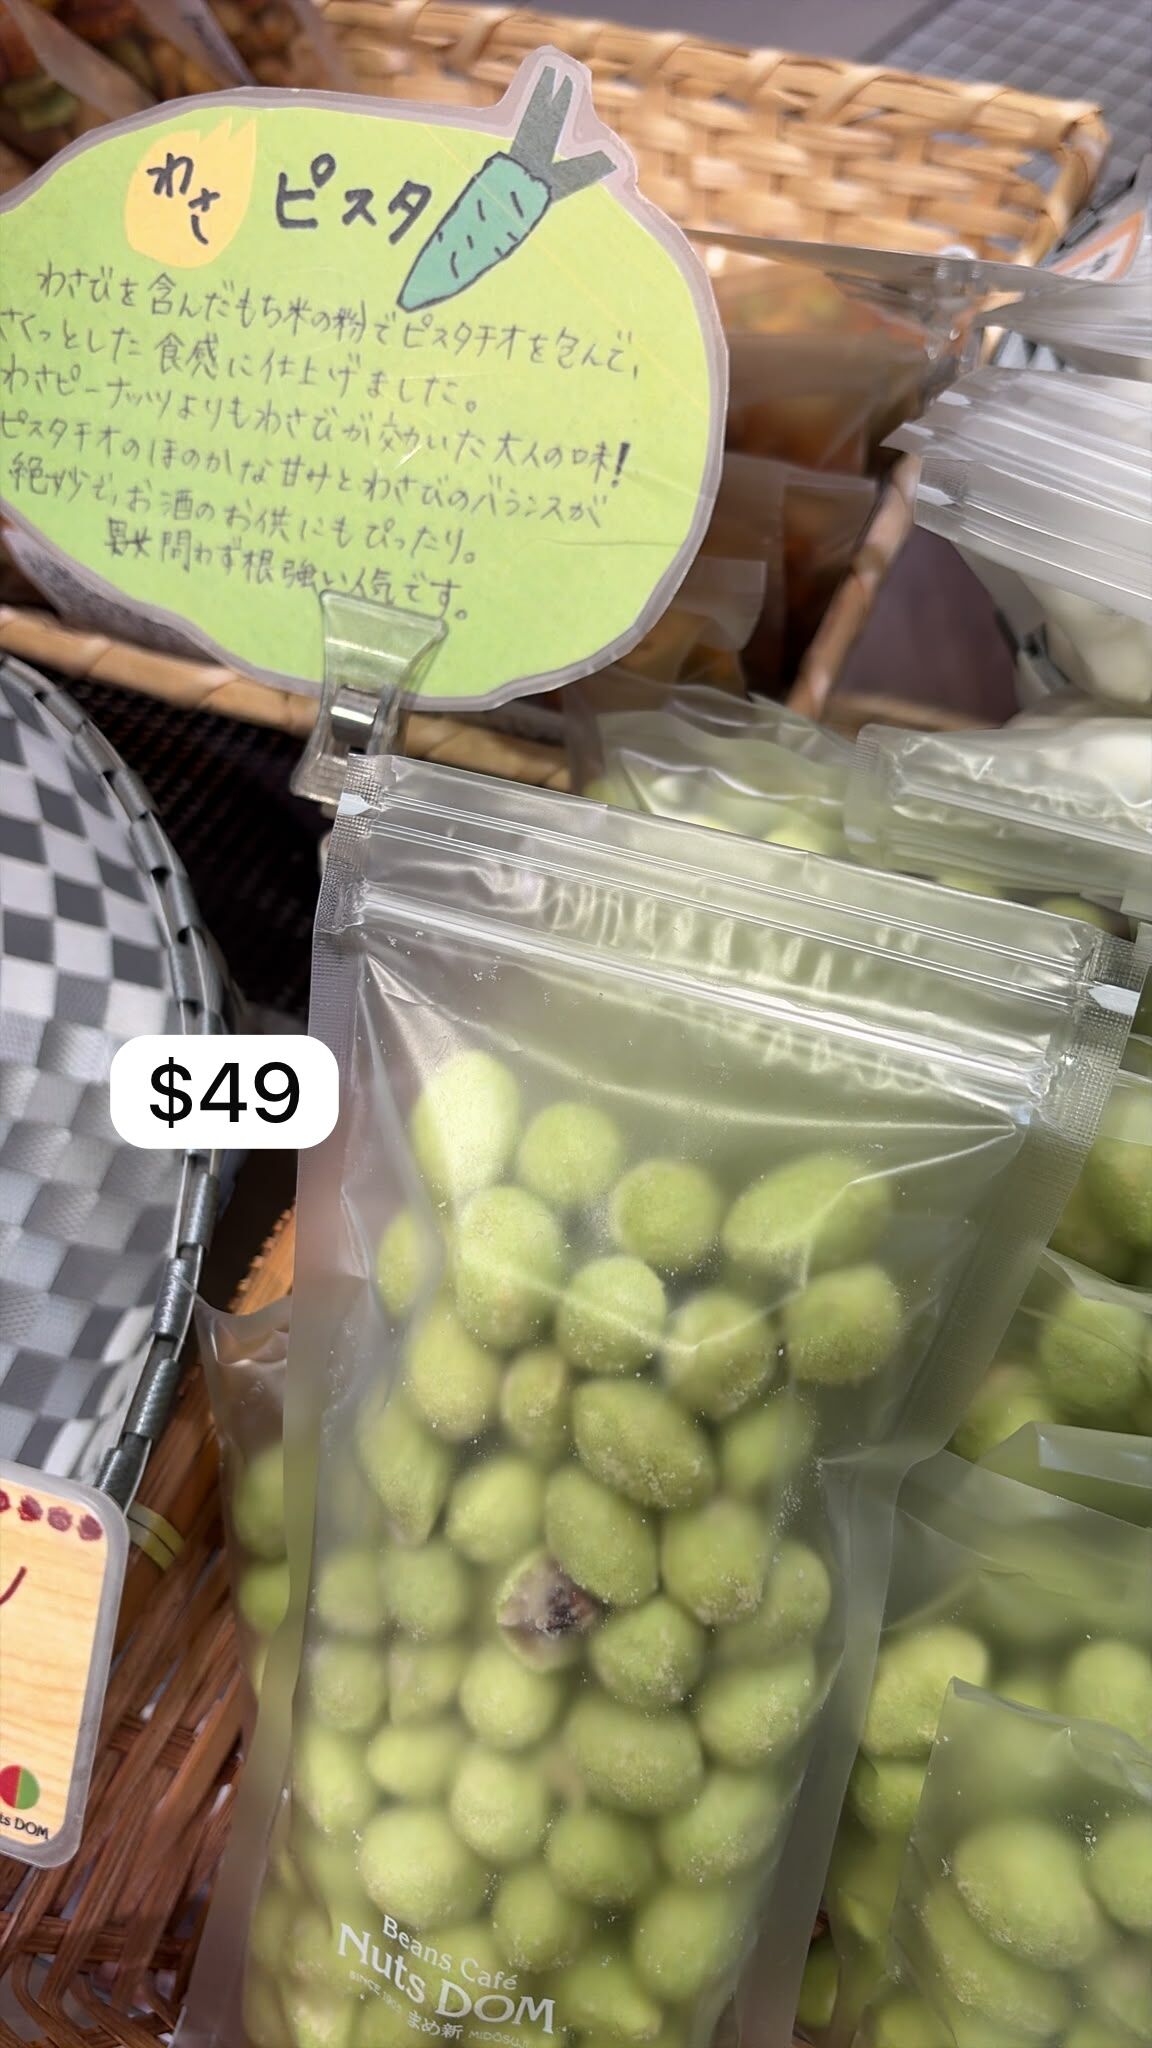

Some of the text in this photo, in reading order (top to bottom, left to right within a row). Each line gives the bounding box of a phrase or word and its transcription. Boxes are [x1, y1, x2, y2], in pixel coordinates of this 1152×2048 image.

[146, 152, 432, 246] わさ ピスタ
[14, 1816, 49, 1840] DOM
[338, 1922, 556, 2035] Nuts DOM
[383, 1914, 518, 1991] Beans Café
[407, 2010, 464, 2041] まめ新
